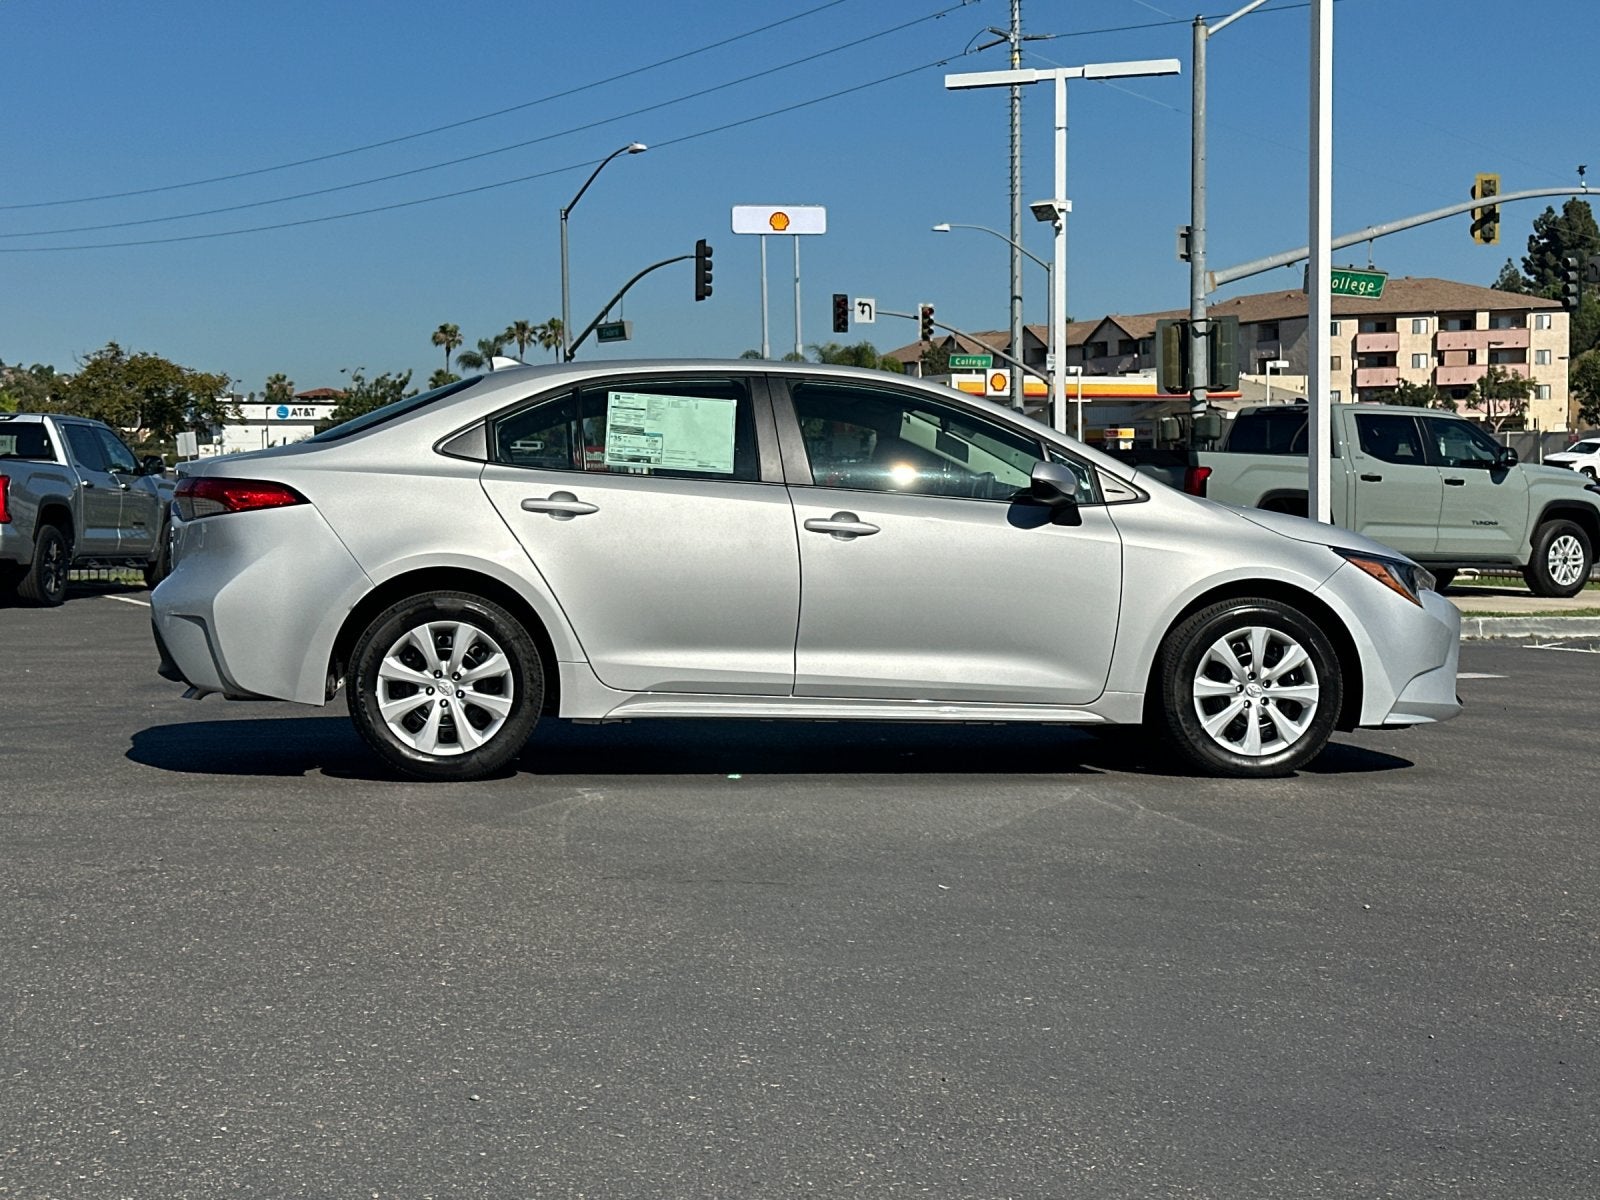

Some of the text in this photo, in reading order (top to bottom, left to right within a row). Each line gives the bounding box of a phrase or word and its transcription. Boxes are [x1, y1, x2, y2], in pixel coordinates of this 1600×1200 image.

[1331, 277, 1374, 295] ollege
[955, 357, 987, 367] College
[290, 407, 316, 417] AT&T
